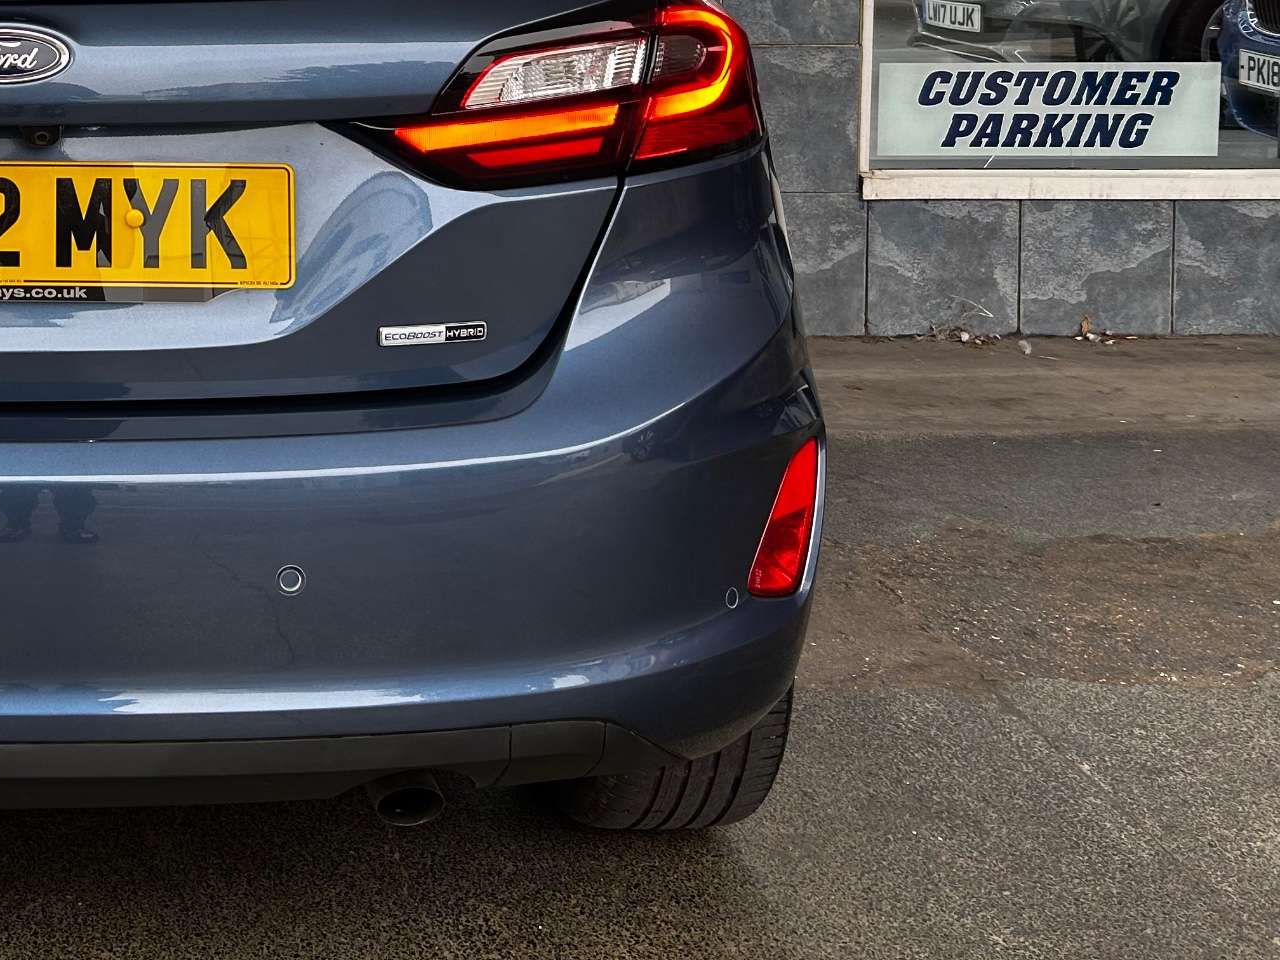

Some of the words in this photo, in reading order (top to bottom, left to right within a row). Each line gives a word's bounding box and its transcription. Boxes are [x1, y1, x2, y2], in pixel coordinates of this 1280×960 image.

[950, 6, 975, 27] UJK
[918, 70, 1181, 106] CUSTOMER
[940, 113, 1155, 149] PARKING
[55, 177, 248, 269] MYK
[446, 327, 484, 338] HYBRID
